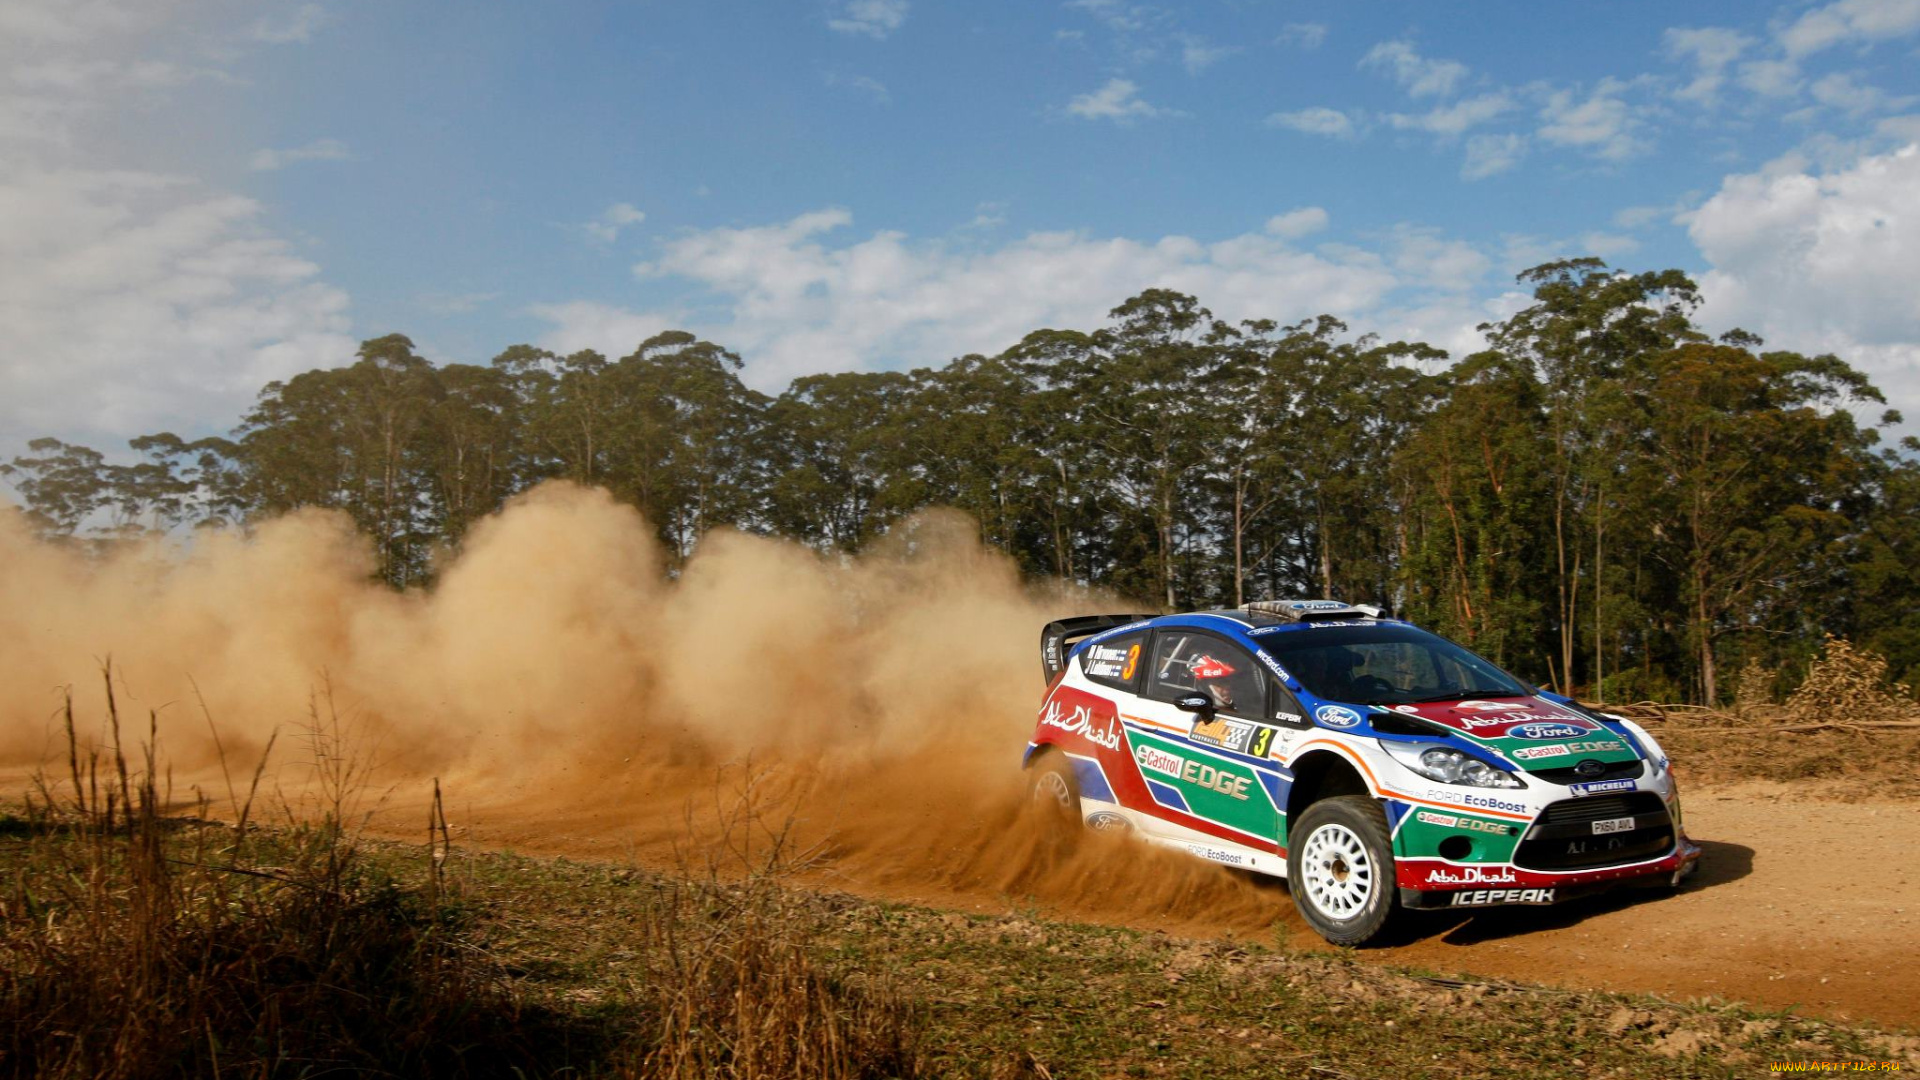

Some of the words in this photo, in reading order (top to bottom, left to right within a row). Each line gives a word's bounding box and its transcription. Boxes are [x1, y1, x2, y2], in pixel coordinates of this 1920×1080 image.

[1122, 643, 1140, 680] 3
[1256, 649, 1290, 683] wrcford.com
[1322, 708, 1354, 726] Ford
[1460, 716, 1499, 730] Abu
[1498, 711, 1583, 725] Dhabi
[1063, 705, 1122, 751] Dhabi
[1523, 724, 1580, 739] Ford
[1191, 734, 1220, 745] AUSTRALIA
[1253, 727, 1271, 757] 3
[1528, 745, 1567, 758] Castrol
[1568, 741, 1626, 754] EDGE
[1146, 751, 1180, 775] Castrol
[1181, 760, 1253, 800] EDGE
[1588, 780, 1634, 792] MICHELIN
[1427, 790, 1463, 803] FORD
[1464, 795, 1527, 813] EcoBoost
[1425, 814, 1456, 826] Castrol
[1457, 818, 1511, 835] EDGE
[1594, 820, 1616, 833] PX60
[1617, 818, 1635, 831] AVL
[1207, 849, 1242, 864] EcoBoost
[1425, 869, 1459, 883] Abu
[1459, 867, 1517, 883] Dhabi
[1451, 888, 1556, 906] ICEPEAK
